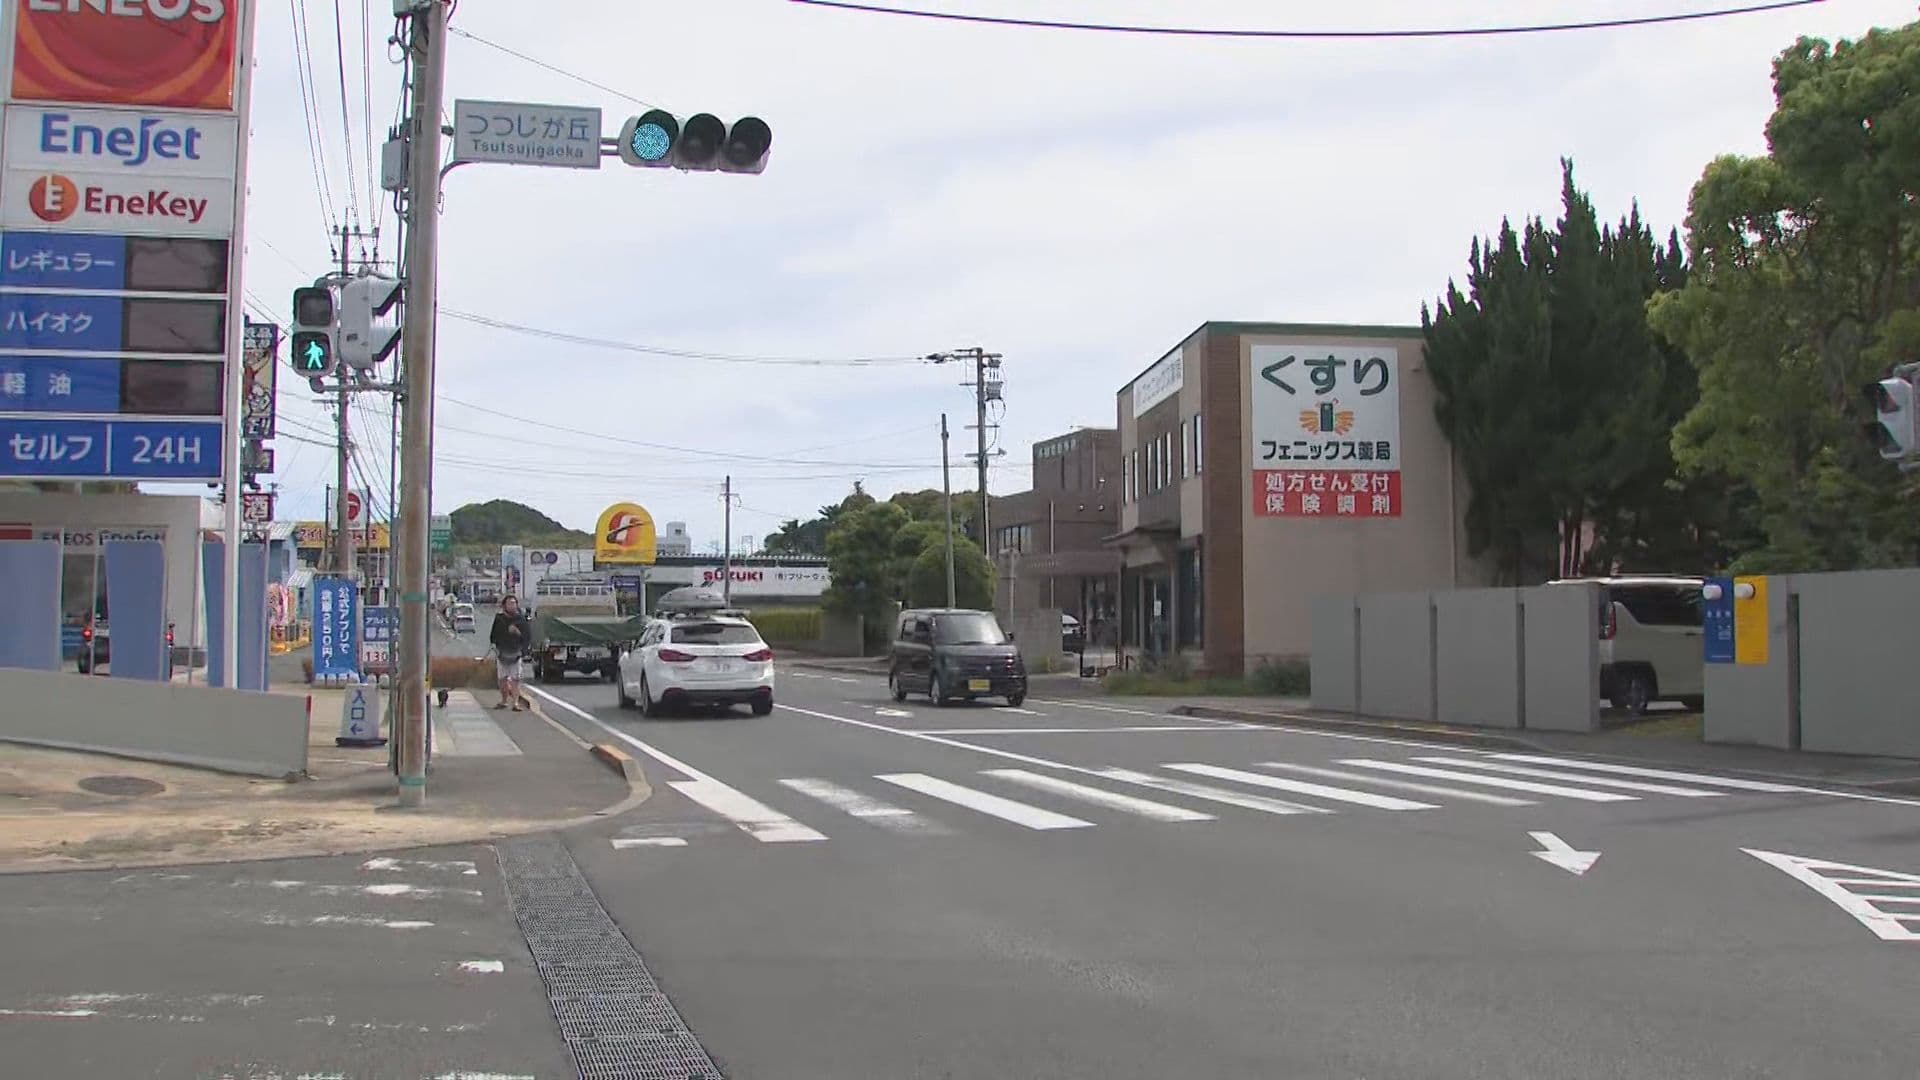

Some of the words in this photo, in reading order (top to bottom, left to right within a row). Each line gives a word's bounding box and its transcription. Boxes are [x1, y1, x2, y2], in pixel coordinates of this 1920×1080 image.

[466, 112, 590, 141] つつじが丘
[472, 138, 584, 160] Tsutsujigaoka
[84, 187, 208, 223] EneKey
[9, 251, 115, 272] レギュラー
[7, 311, 93, 332] ハイオク
[1261, 354, 1390, 396] くすり
[9, 433, 93, 461] セルフ
[132, 435, 201, 464] 24H
[1261, 440, 1391, 461] フェニックス薬局
[1265, 472, 1390, 492] 処方せん受付
[1265, 494, 1390, 514] 保険調剤
[351, 689, 366, 719] 入口
